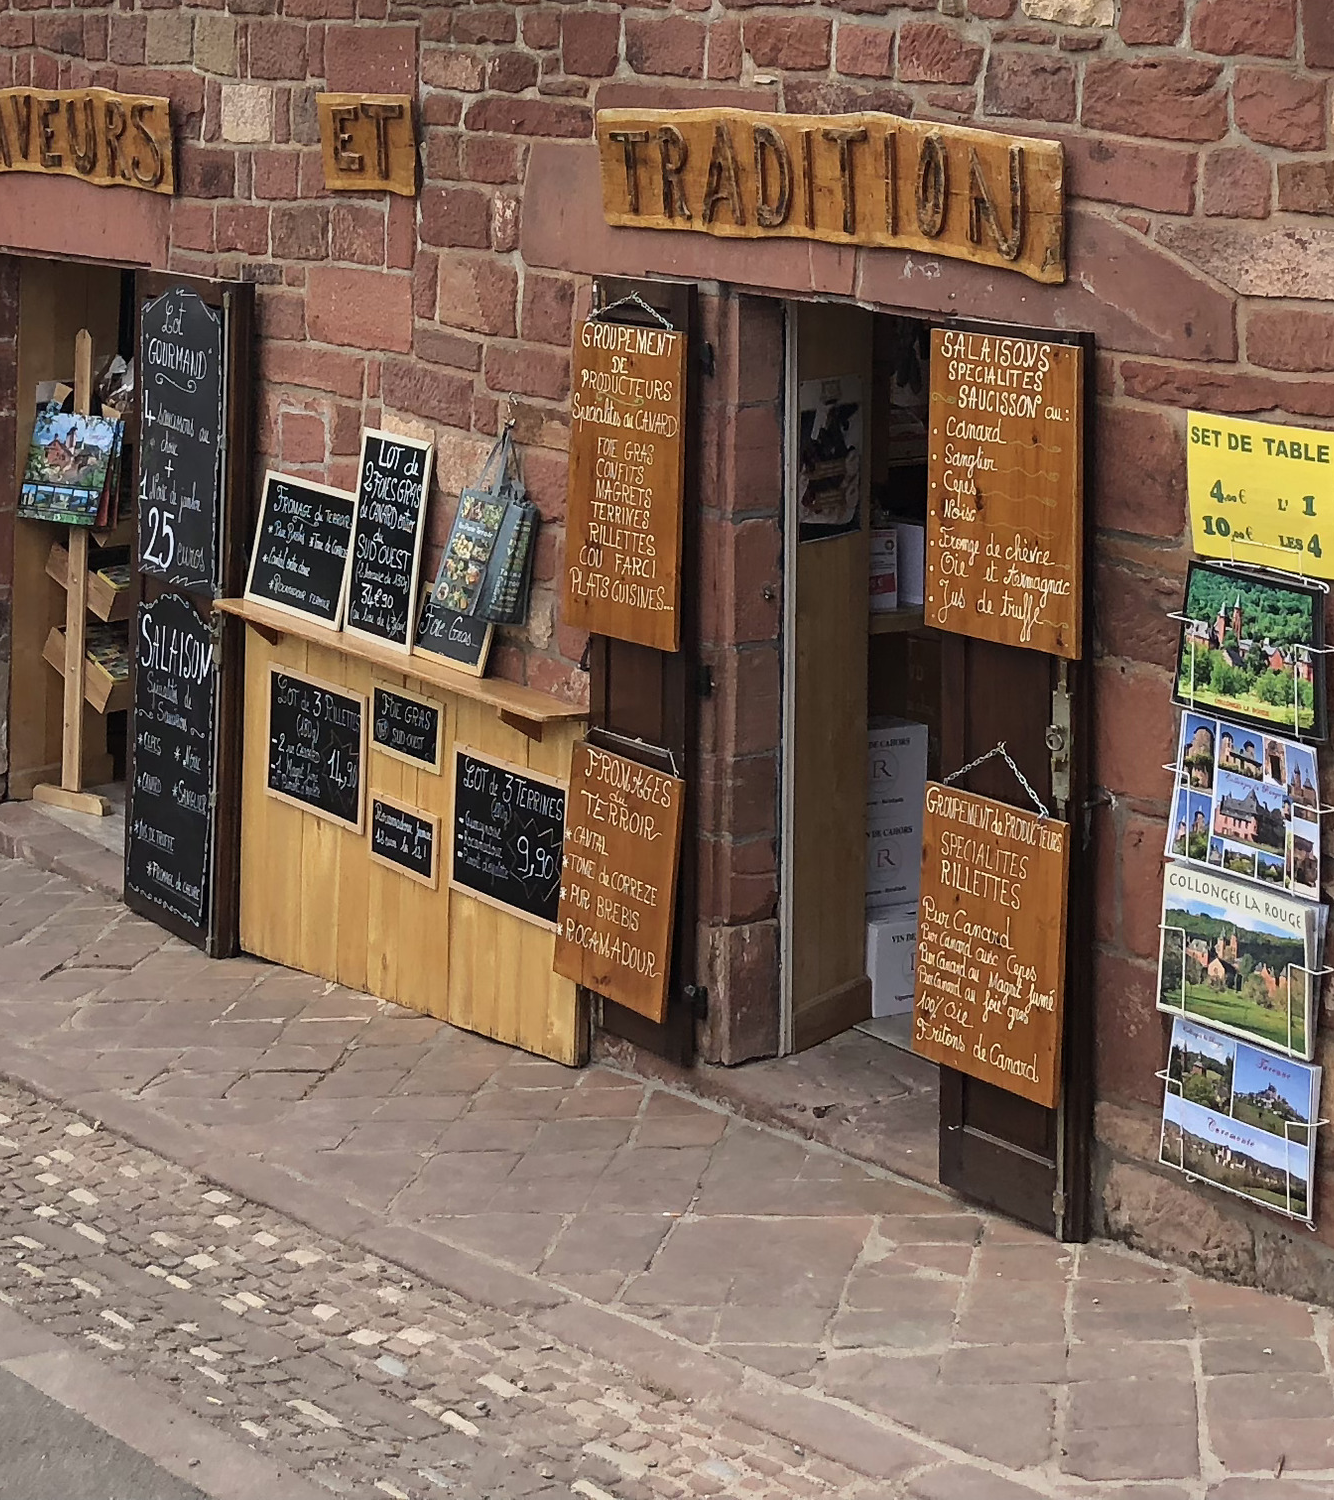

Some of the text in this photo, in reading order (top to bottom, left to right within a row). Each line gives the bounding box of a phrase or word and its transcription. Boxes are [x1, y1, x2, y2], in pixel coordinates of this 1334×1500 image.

[330, 102, 404, 180] ET
[609, 121, 1025, 261] TRADITION
[161, 300, 186, 336] Lot
[581, 322, 676, 358] GROUPEMENT
[941, 332, 1050, 373] SALAISONS
[611, 356, 629, 374] DE
[948, 360, 1043, 392] SPECIALITES
[581, 369, 673, 402] PRODUCTEURS
[958, 385, 1042, 418] SAUCISSON
[145, 390, 157, 427] 4
[623, 410, 678, 438] au CANARD
[946, 416, 1007, 444] Canard
[1190, 426, 1330, 464] SET DE TABLE
[379, 440, 420, 476] LOT de
[597, 437, 655, 466] FOIE GRAS
[945, 443, 998, 479] Sanglier
[139, 468, 148, 500] 1
[363, 461, 422, 509] 2 FOIES GRAS
[596, 458, 645, 485] CONFITS
[944, 470, 977, 507] Cepes
[273, 484, 313, 519] FROMAGE
[595, 479, 653, 509] MAGRETS
[1302, 496, 1317, 516] 1
[590, 500, 650, 530] TERRINES
[143, 507, 206, 573] 25 euros
[357, 533, 411, 571] SUD OUEST
[588, 522, 656, 557] RILLETTES
[986, 533, 1002, 559] de
[1006, 534, 1055, 565] chèvre
[1278, 535, 1304, 551] LES
[1307, 534, 1322, 559] 4
[579, 545, 656, 578] COU FARCI
[940, 551, 1071, 609] Oie et Armagnac
[569, 566, 610, 599] PLATS
[937, 578, 1044, 643] Jus de truffe
[141, 613, 213, 685] SALAISON
[313, 691, 322, 717] 3
[381, 692, 402, 720] FOIE
[404, 706, 432, 731] GRAS
[463, 758, 490, 793] LOT
[489, 773, 499, 797] de
[502, 773, 514, 803] 3
[515, 778, 564, 821] TERRINES
[584, 749, 672, 808] FROMAGES
[581, 789, 662, 841] TERROIR
[609, 789, 627, 806] du
[883, 825, 913, 837] CAHORS
[926, 787, 1063, 853] GROUPEMENT de PRODUCTEURS
[517, 836, 554, 881] 9,90
[574, 825, 609, 856] CANTAL
[941, 831, 1029, 880] SPECIALITES
[569, 853, 657, 907] TOME de CORREZE
[941, 860, 1021, 910] RILLETTES
[569, 883, 640, 932] PUR BREBIS
[1169, 873, 1301, 930] COLLONGES LA ROUGE
[891, 934, 904, 944] VIN
[922, 895, 1014, 951] Pur Canard
[565, 917, 662, 978] ROCAMADOUR
[921, 922, 938, 944] Pur
[939, 931, 973, 959] Canard
[1006, 954, 1037, 988] Cepes
[919, 941, 936, 967] Pur
[936, 951, 967, 979] Canard
[968, 967, 979, 983] au
[1025, 982, 1055, 1013] fumé
[916, 990, 974, 1028] 100% Oie
[917, 965, 1028, 1031] Pur Canard au foie gras
[916, 1017, 1039, 1083] Fritons de Canard
[1256, 1058, 1291, 1080] Turenne
